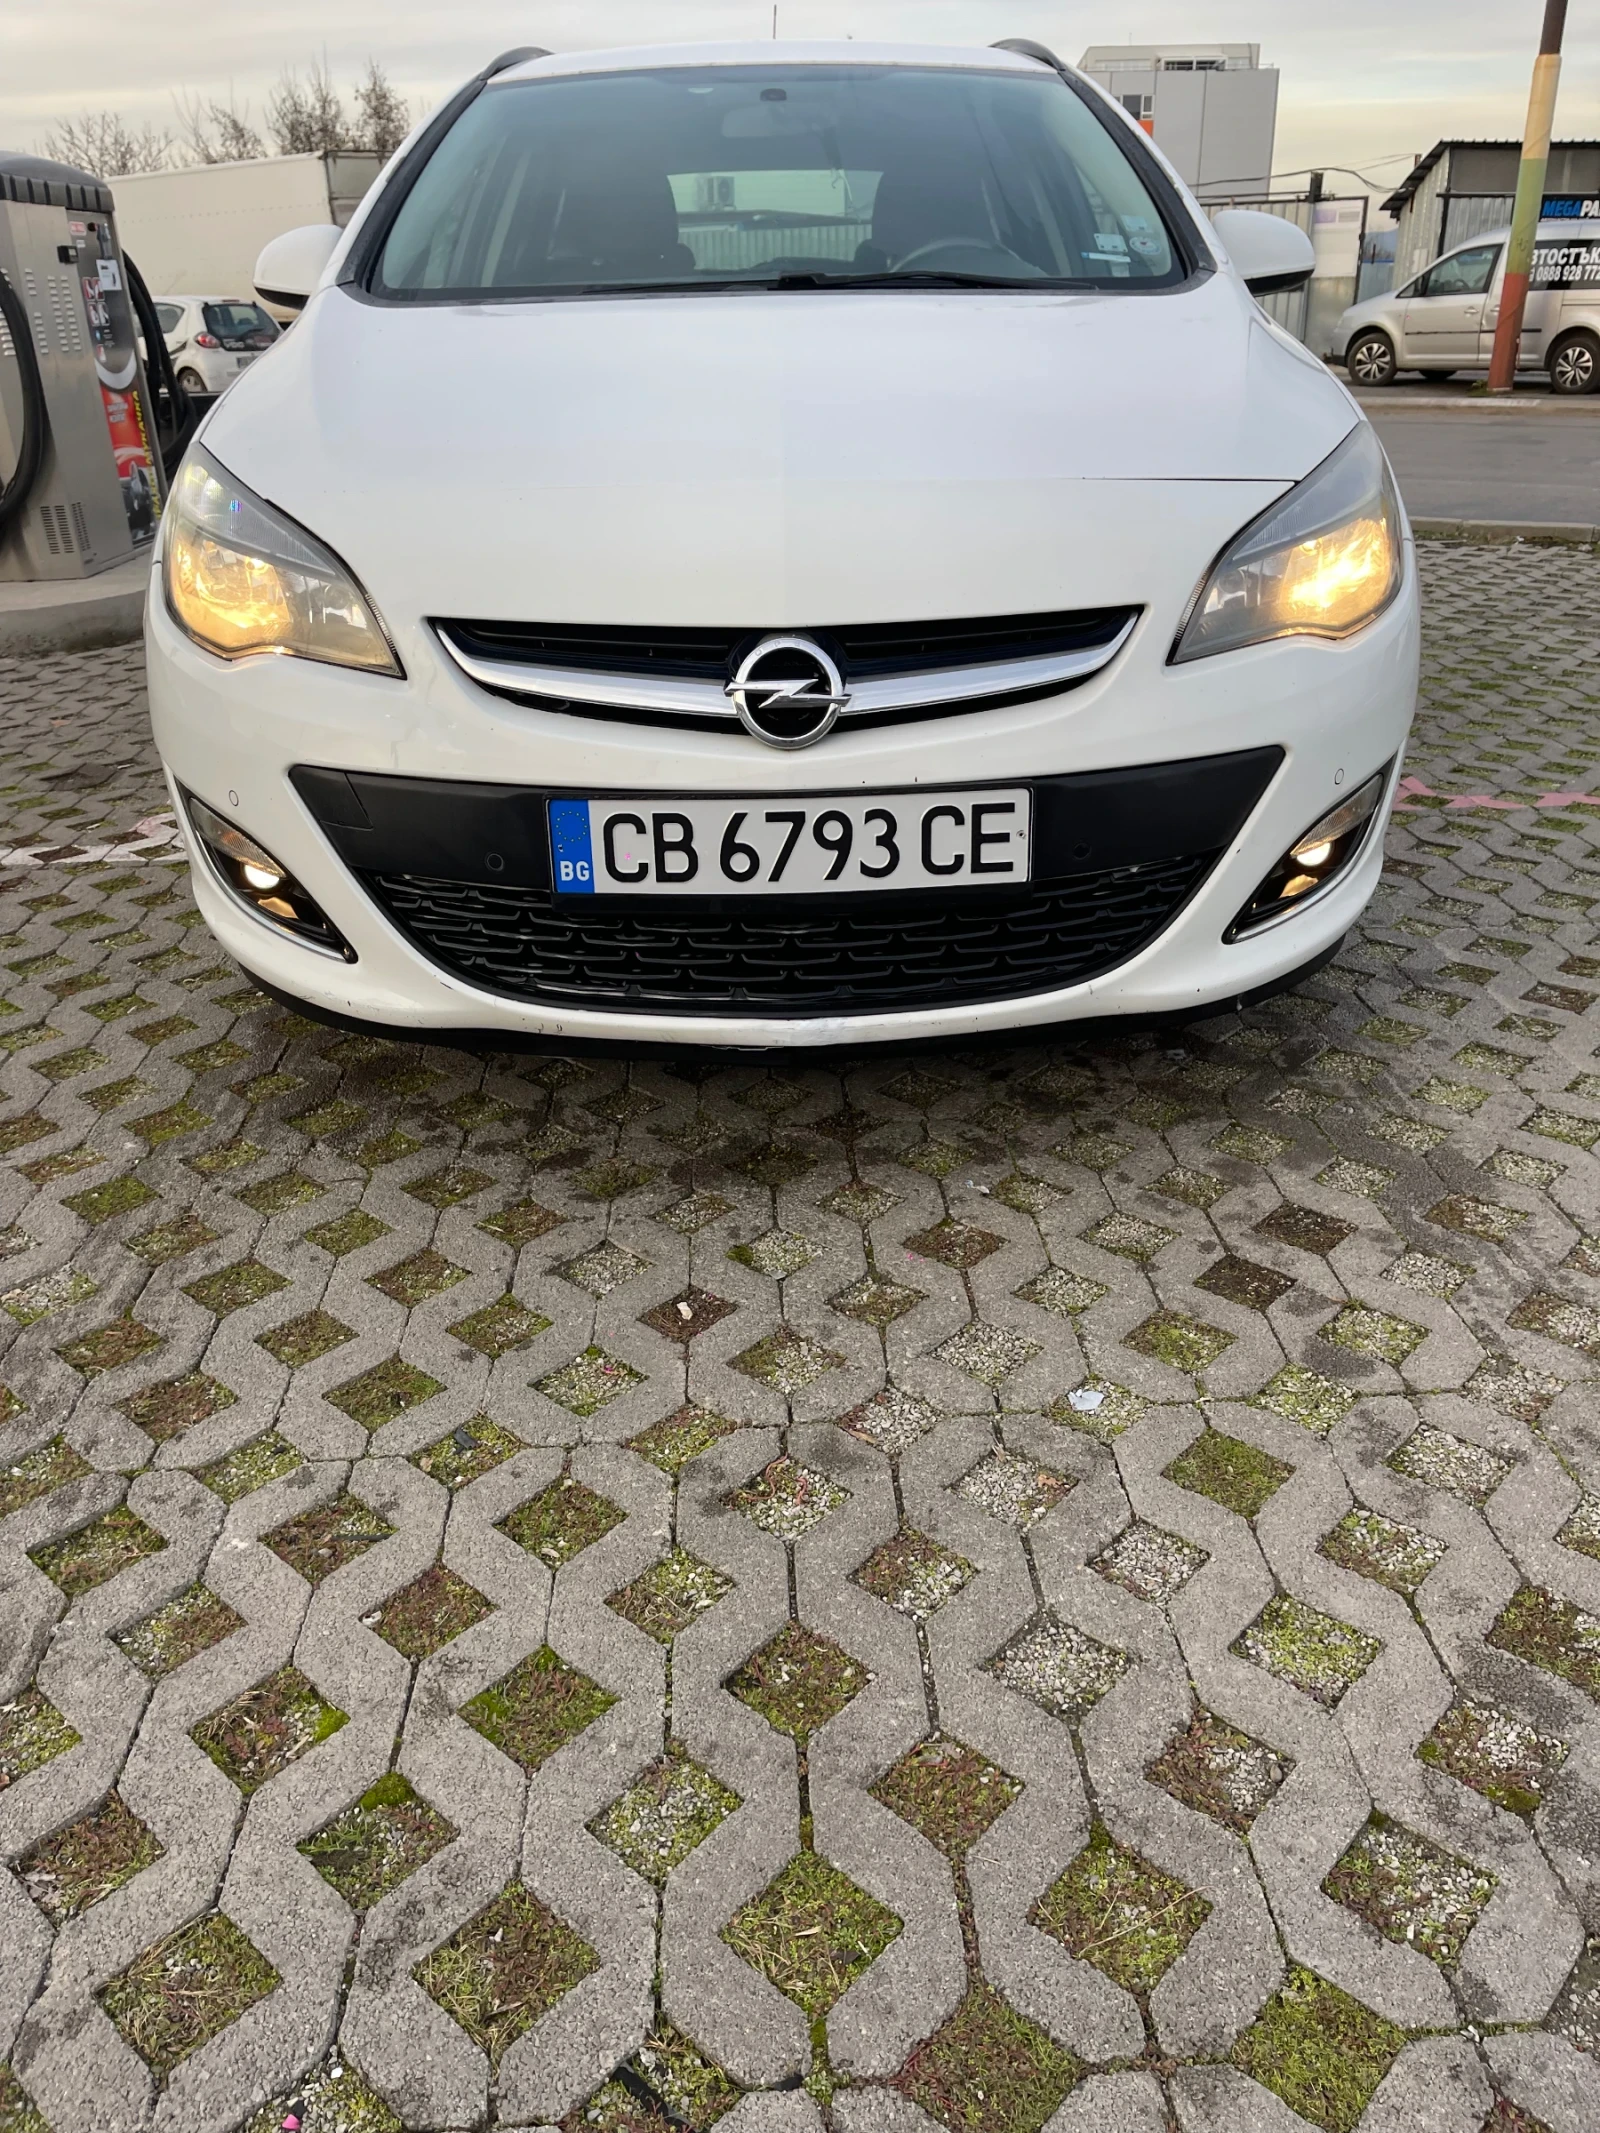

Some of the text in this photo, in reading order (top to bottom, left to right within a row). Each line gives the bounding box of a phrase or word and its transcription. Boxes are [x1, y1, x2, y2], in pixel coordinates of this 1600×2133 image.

[1536, 266, 1561, 281] 0888
[1562, 265, 1583, 281] 928
[603, 802, 1016, 883] CB 6793 CE
[560, 861, 590, 882] BG
